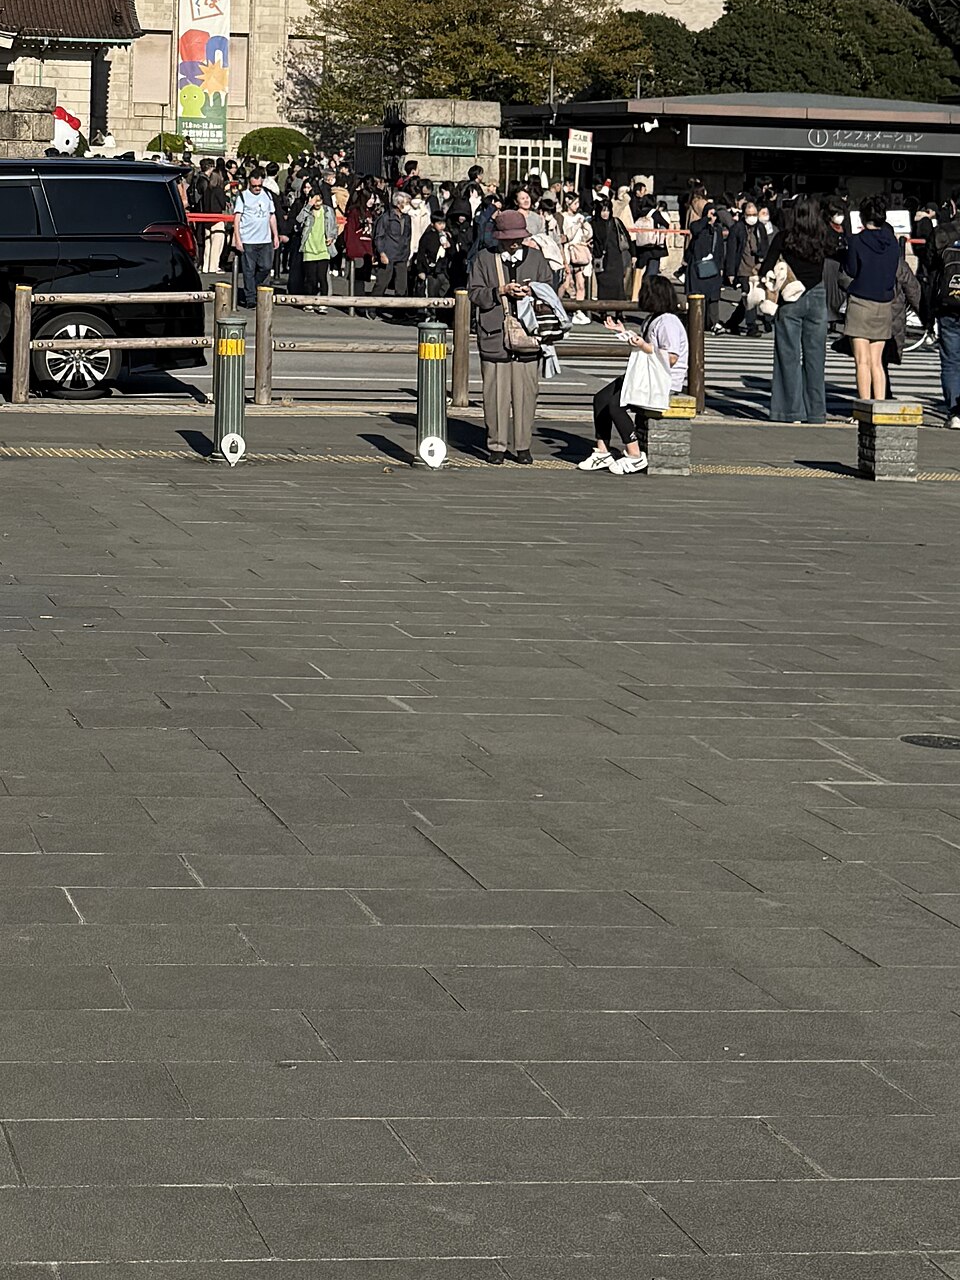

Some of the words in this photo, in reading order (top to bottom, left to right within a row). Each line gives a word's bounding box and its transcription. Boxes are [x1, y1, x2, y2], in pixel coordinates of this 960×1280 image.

[832, 130, 924, 142] インフォメーション
